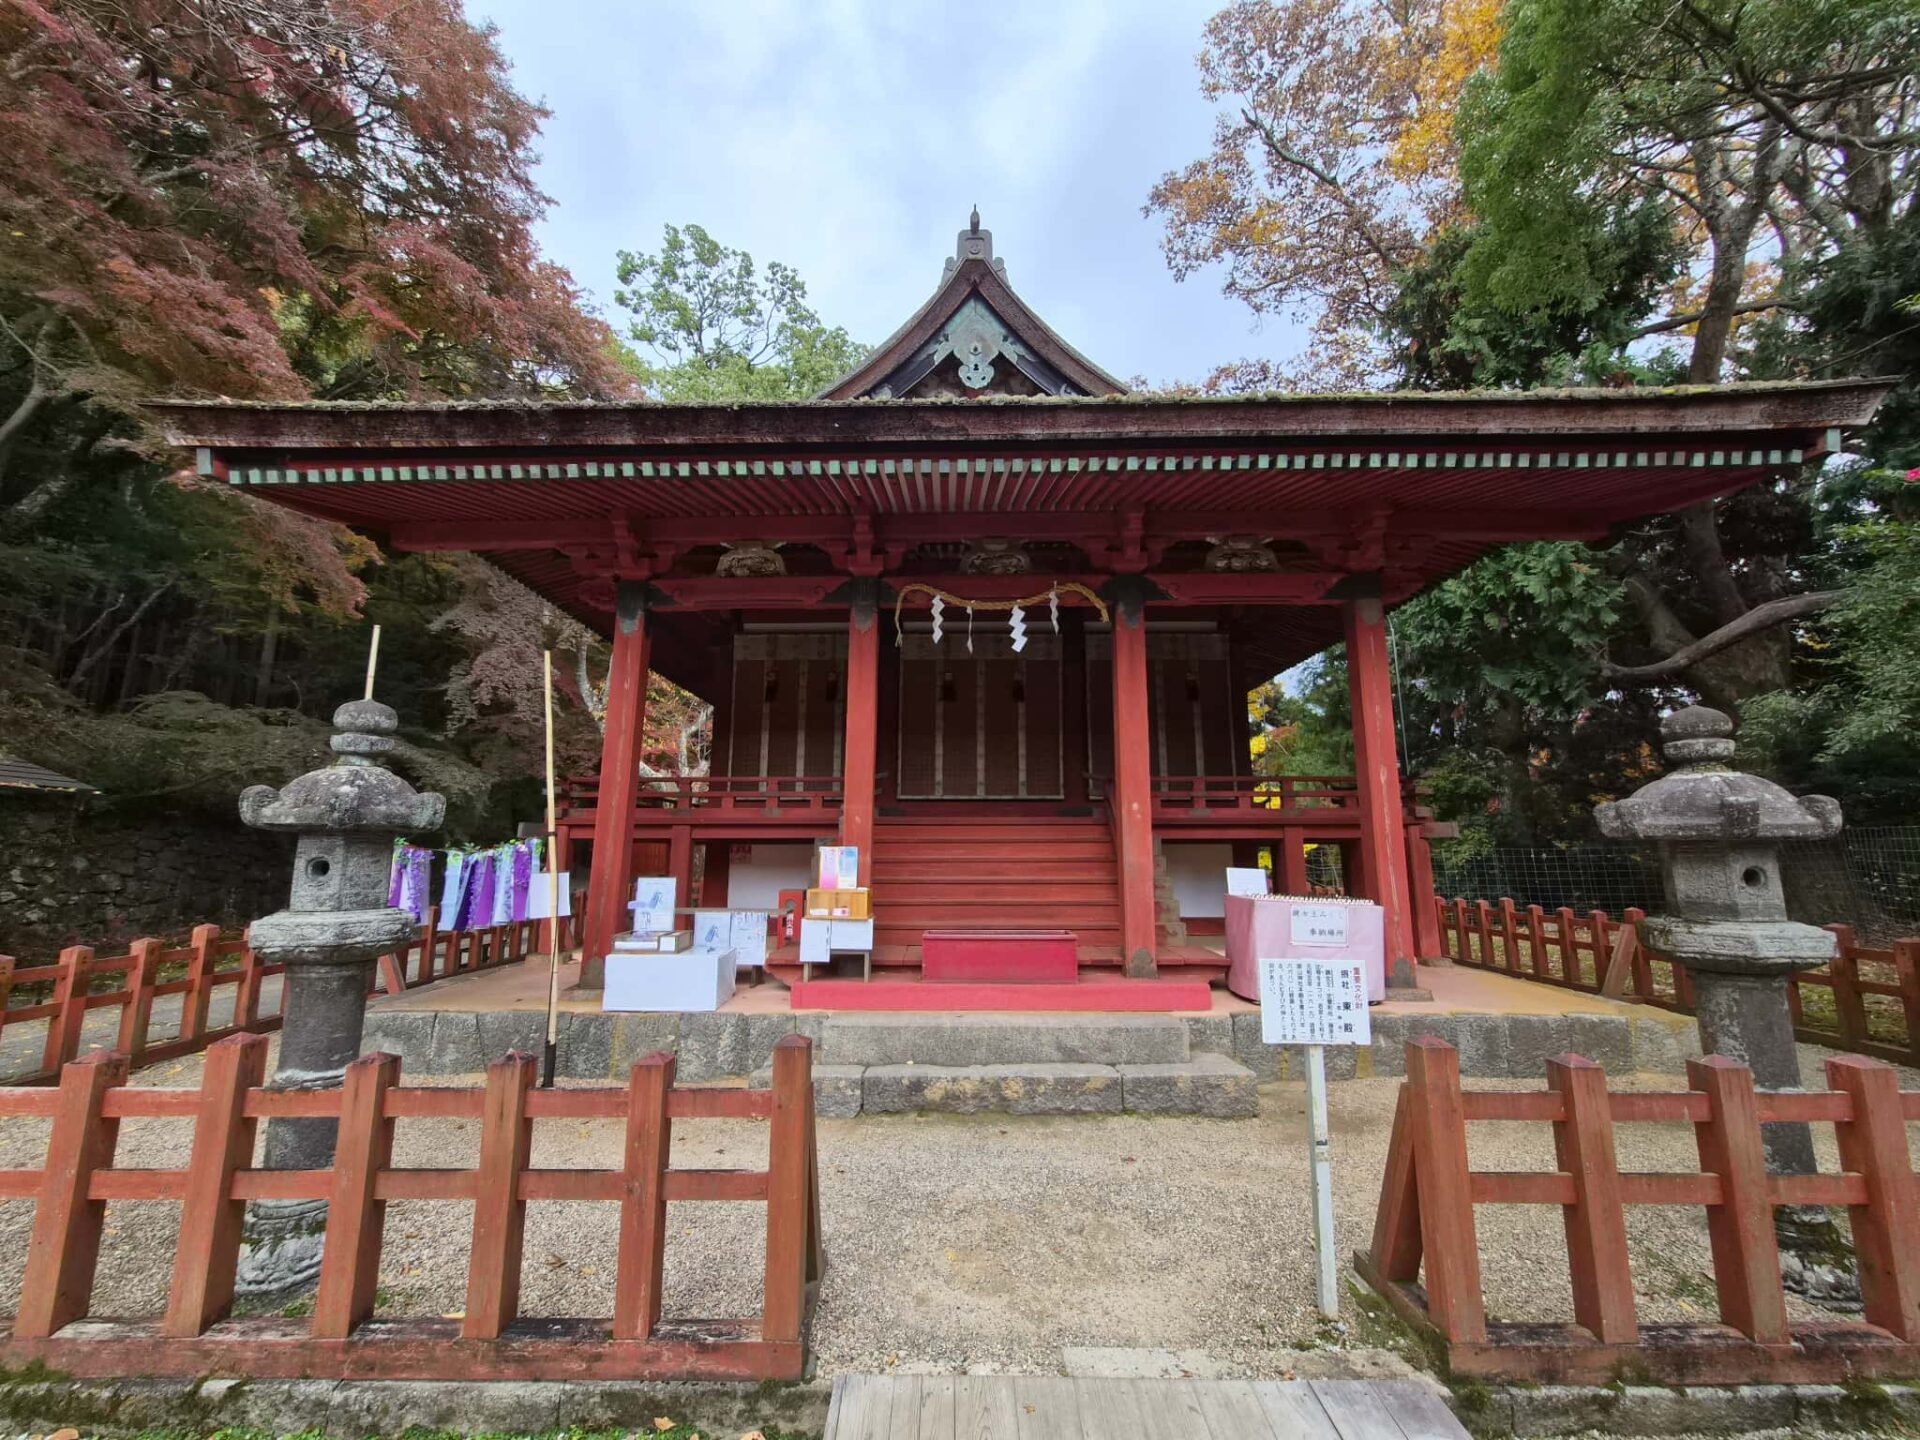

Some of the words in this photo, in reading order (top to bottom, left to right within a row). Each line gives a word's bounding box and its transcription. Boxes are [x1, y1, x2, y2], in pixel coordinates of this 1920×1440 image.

[1353, 967, 1363, 1010] 重要文化財
